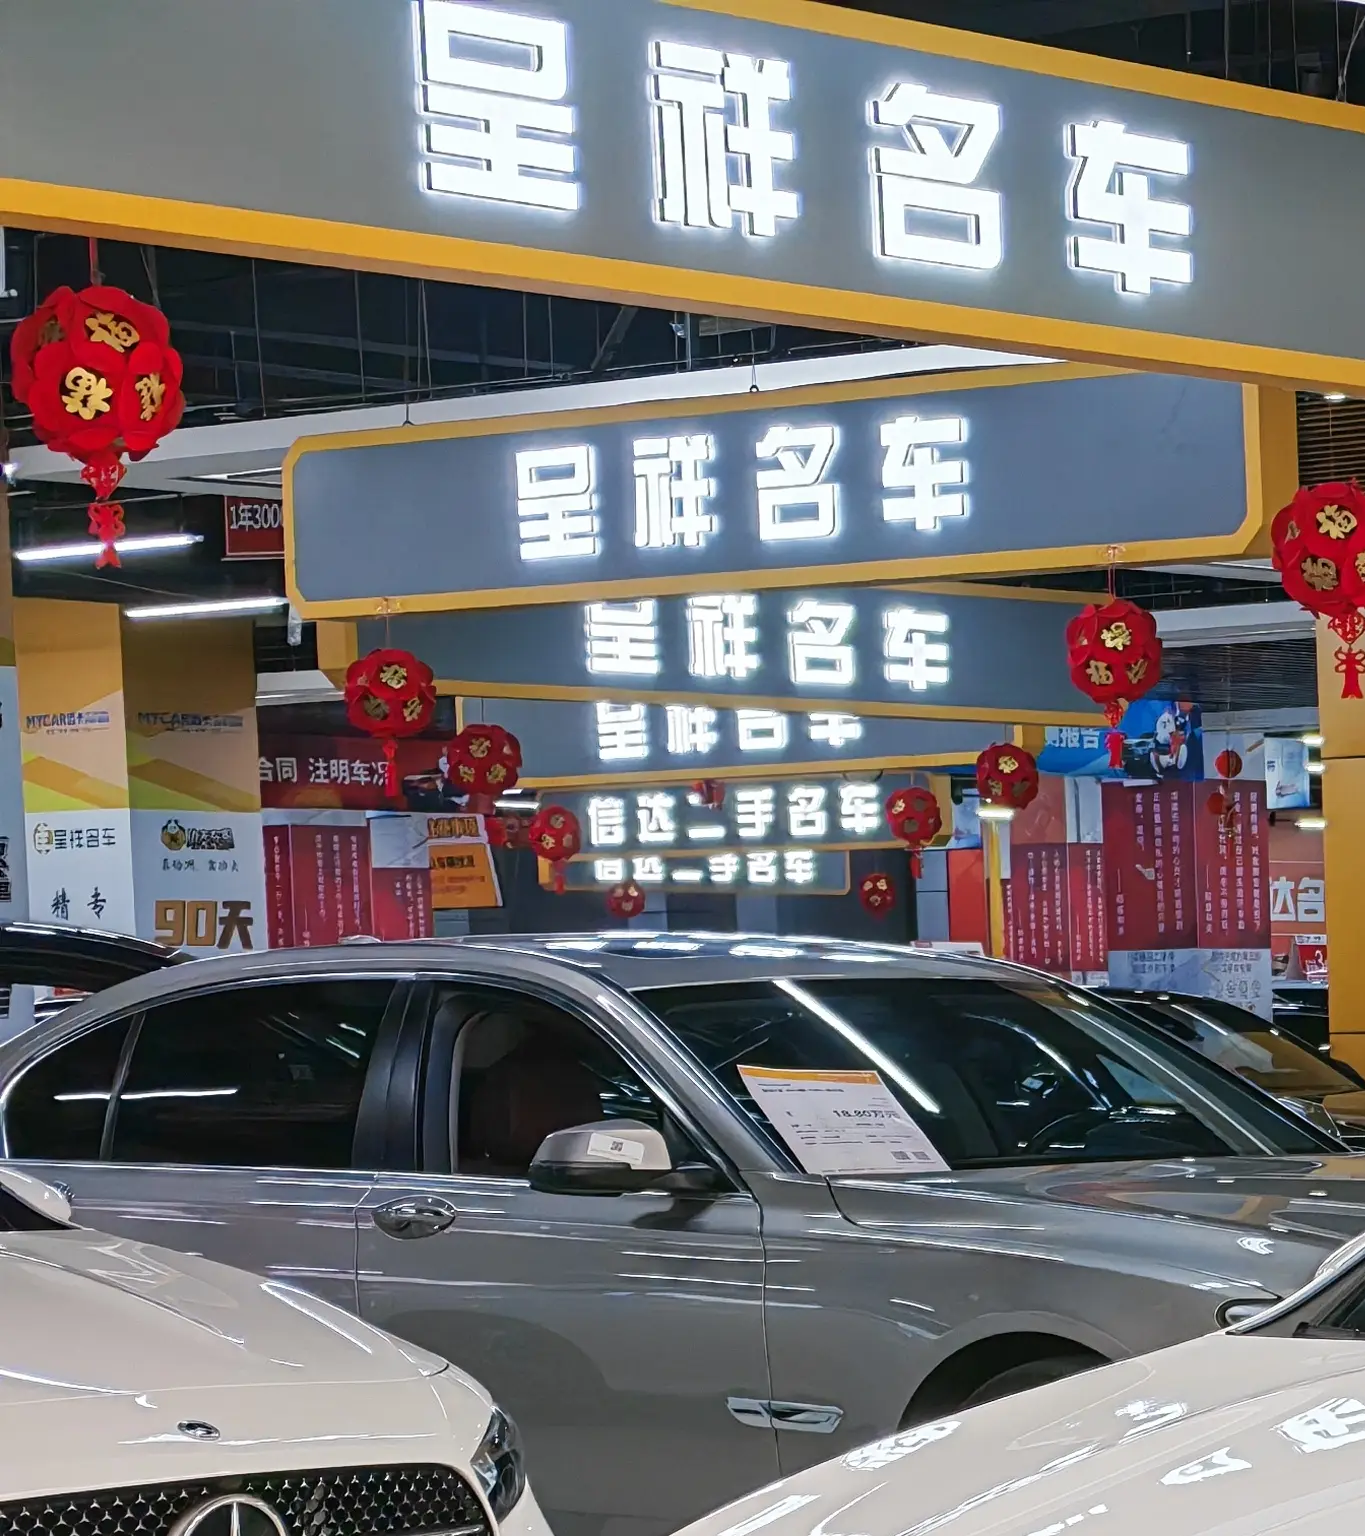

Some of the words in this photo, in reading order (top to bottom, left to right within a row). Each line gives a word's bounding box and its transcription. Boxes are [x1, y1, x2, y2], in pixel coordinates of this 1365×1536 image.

[418, 0, 1194, 295] 呈祥名车
[516, 416, 968, 562] 呈祥名车
[584, 594, 950, 692] 呈祥名车
[155, 900, 254, 950] 90天
